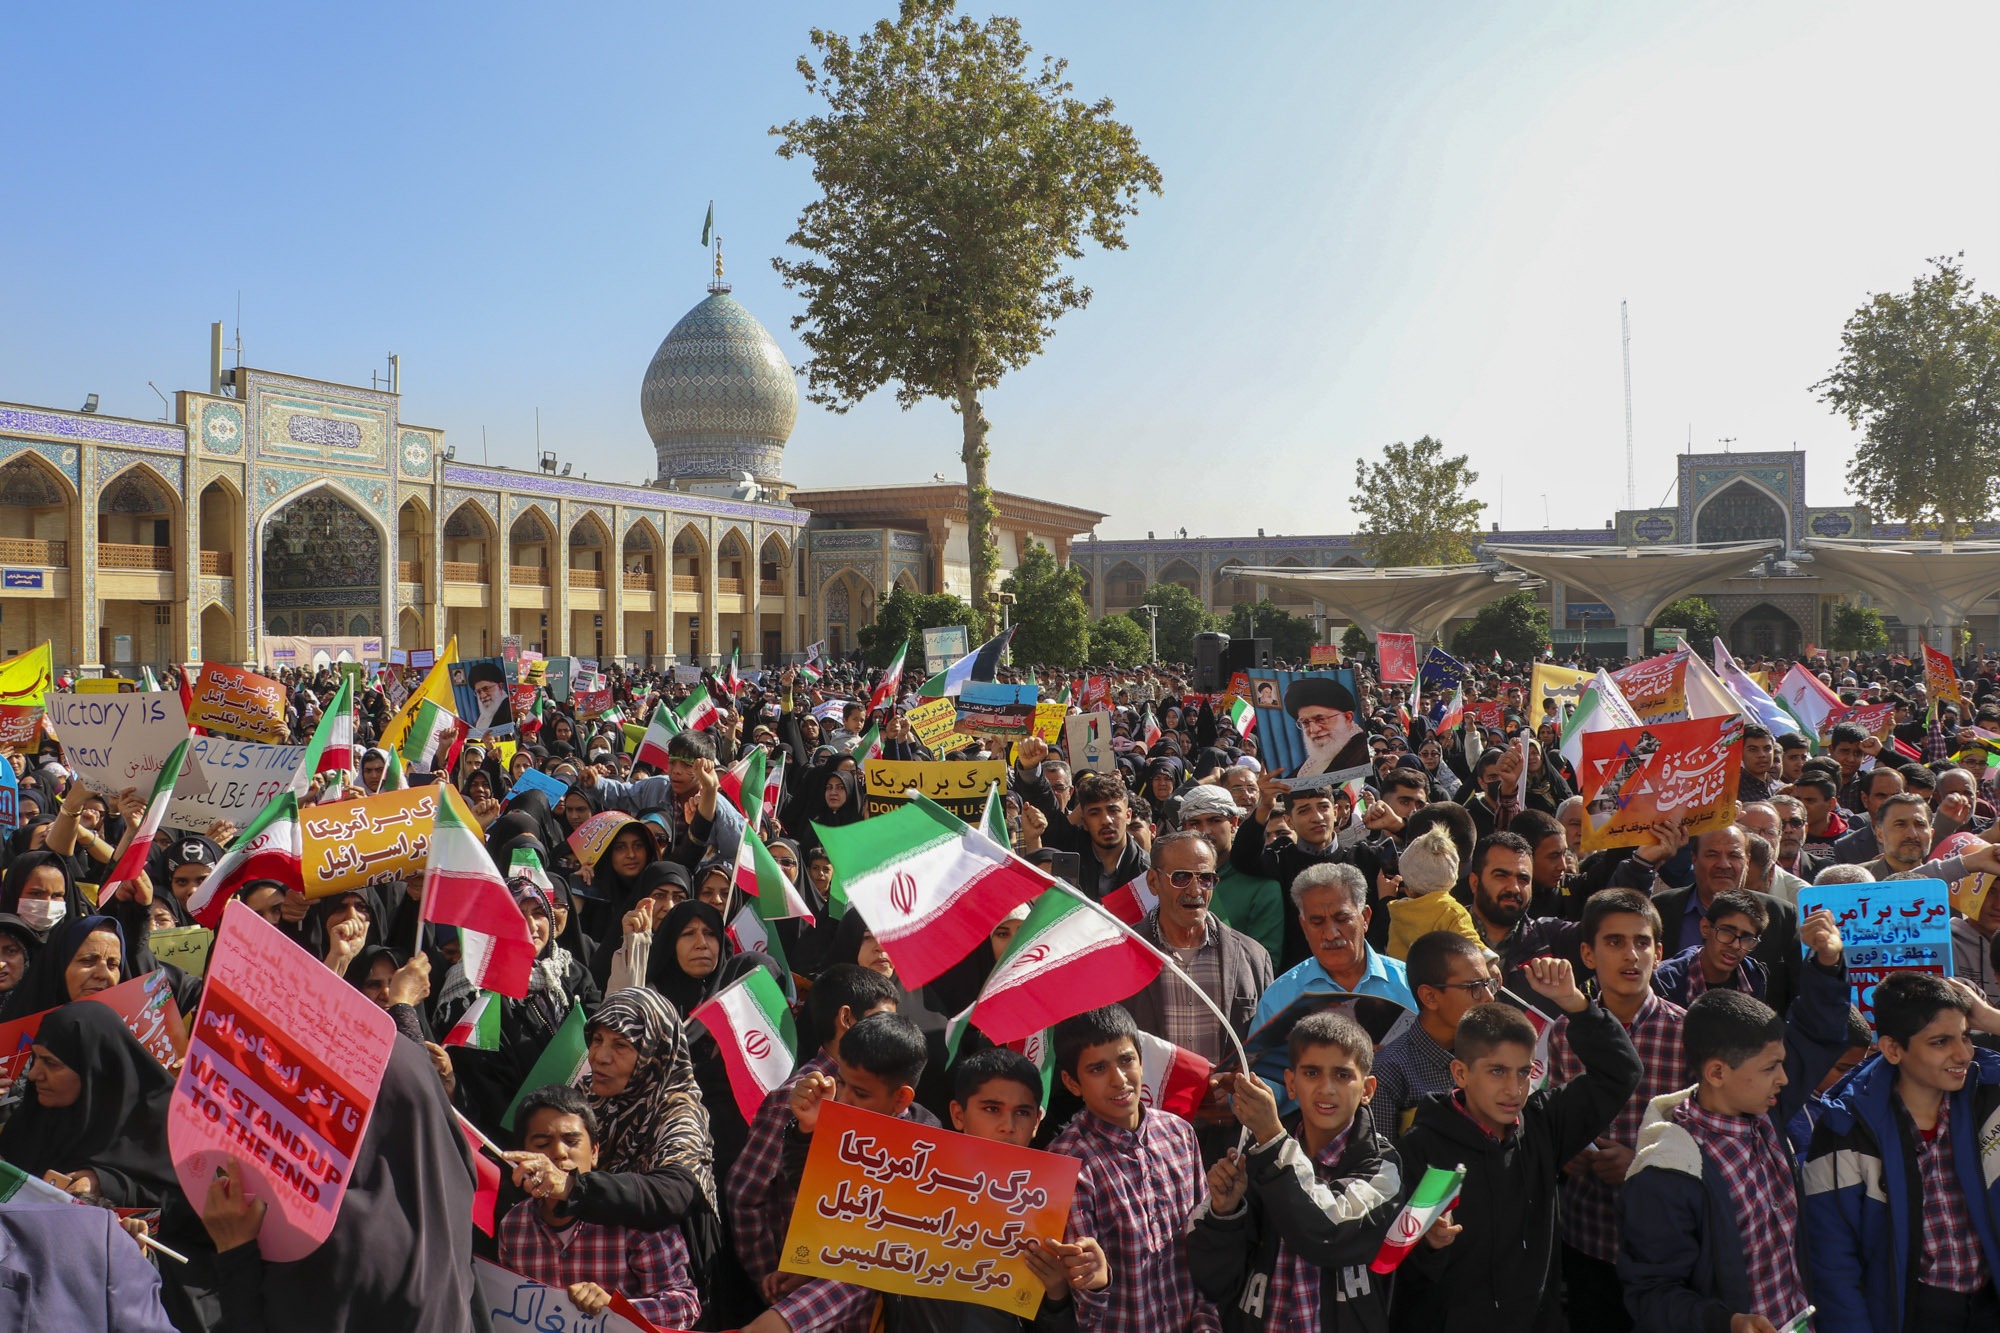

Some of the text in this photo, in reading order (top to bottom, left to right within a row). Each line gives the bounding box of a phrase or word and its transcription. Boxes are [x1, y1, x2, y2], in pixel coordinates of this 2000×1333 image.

[210, 671, 279, 701] مرگ بر آمریکا
[142, 697, 165, 724] is
[201, 690, 279, 720] مرگ بر اسرائیل
[201, 712, 270, 734] مرگ بر انگلیس
[965, 714, 1022, 728] فلسطین
[67, 746, 112, 768] near
[194, 740, 306, 771] ALESTINE
[932, 778, 949, 795] بر
[958, 768, 1001, 793] مرگ
[220, 782, 248, 808] BE
[306, 806, 370, 840] آمریکا
[371, 807, 413, 833] بر
[318, 832, 429, 881] بر اسرائیل
[1873, 905, 1892, 925] بر
[1900, 898, 1946, 923] مرگ
[1881, 927, 1920, 943] دارای
[165, 941, 201, 957] مرگ بر
[1851, 946, 1938, 965] منطقی و قوی
[296, 1083, 345, 1117] آخر
[341, 1106, 361, 1133] تا
[189, 1085, 320, 1203] TO THE END
[837, 1130, 1048, 1215] مرگ بر آمریکا
[816, 1180, 1041, 1258] مرگ بر اسرائیل
[818, 1239, 1013, 1294] مرگ بر انگلیس
